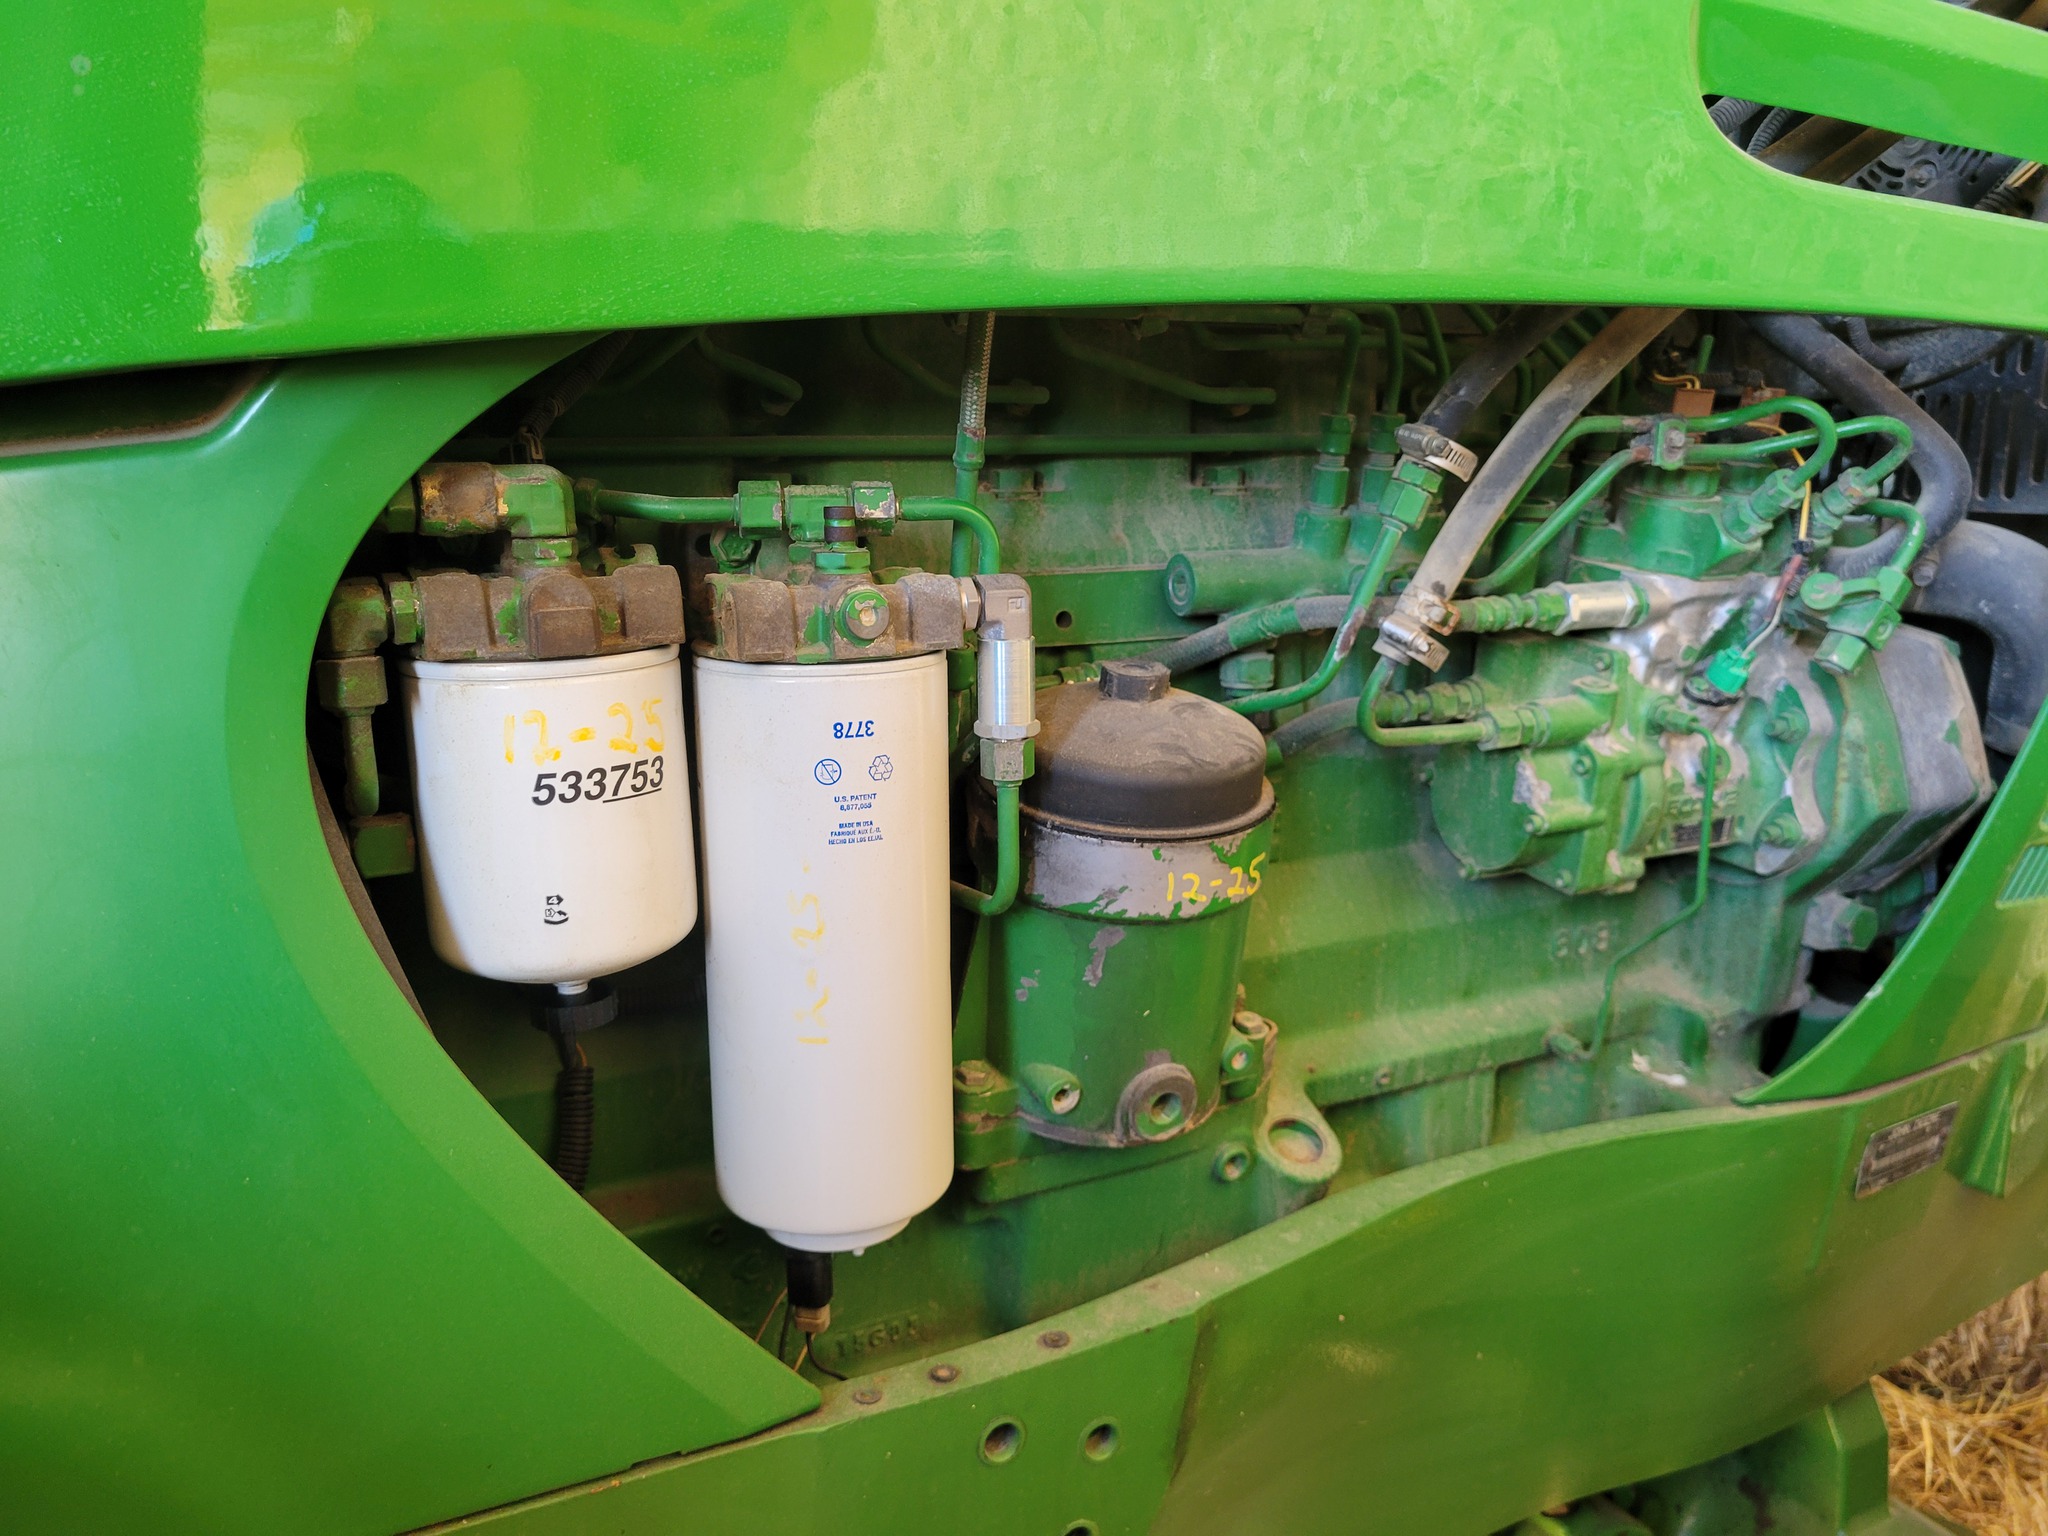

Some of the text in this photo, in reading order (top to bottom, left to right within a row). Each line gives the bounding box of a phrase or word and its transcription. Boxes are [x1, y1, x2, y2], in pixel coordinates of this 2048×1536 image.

[504, 698, 664, 765] 12-25
[832, 720, 875, 739] 3778
[532, 755, 664, 806] 533753
[850, 793, 877, 801] PATENT
[1167, 852, 1266, 902] 12-25
